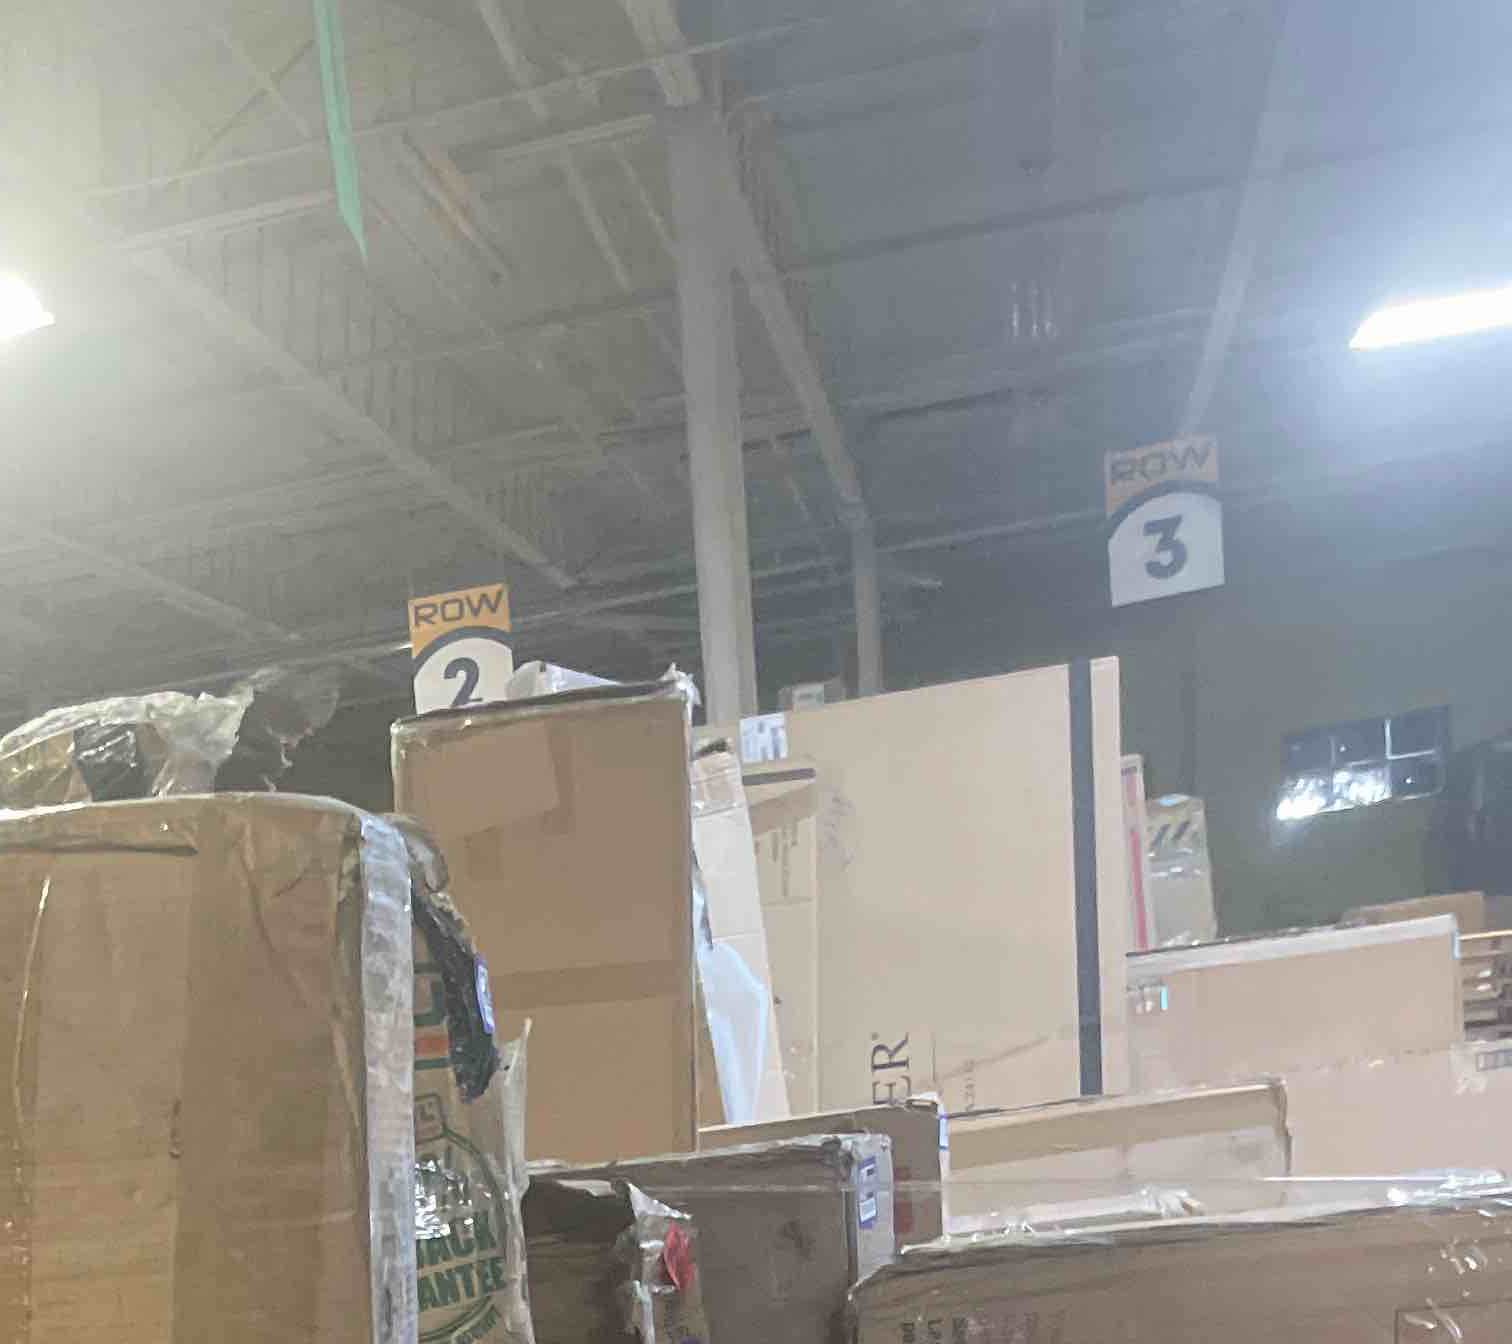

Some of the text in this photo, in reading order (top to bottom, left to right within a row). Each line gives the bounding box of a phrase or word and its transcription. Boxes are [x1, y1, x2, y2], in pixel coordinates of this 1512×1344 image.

[1110, 445, 1209, 486] ROW
[1142, 514, 1188, 580] 3
[413, 591, 505, 628] ROW
[443, 656, 484, 708] 2
